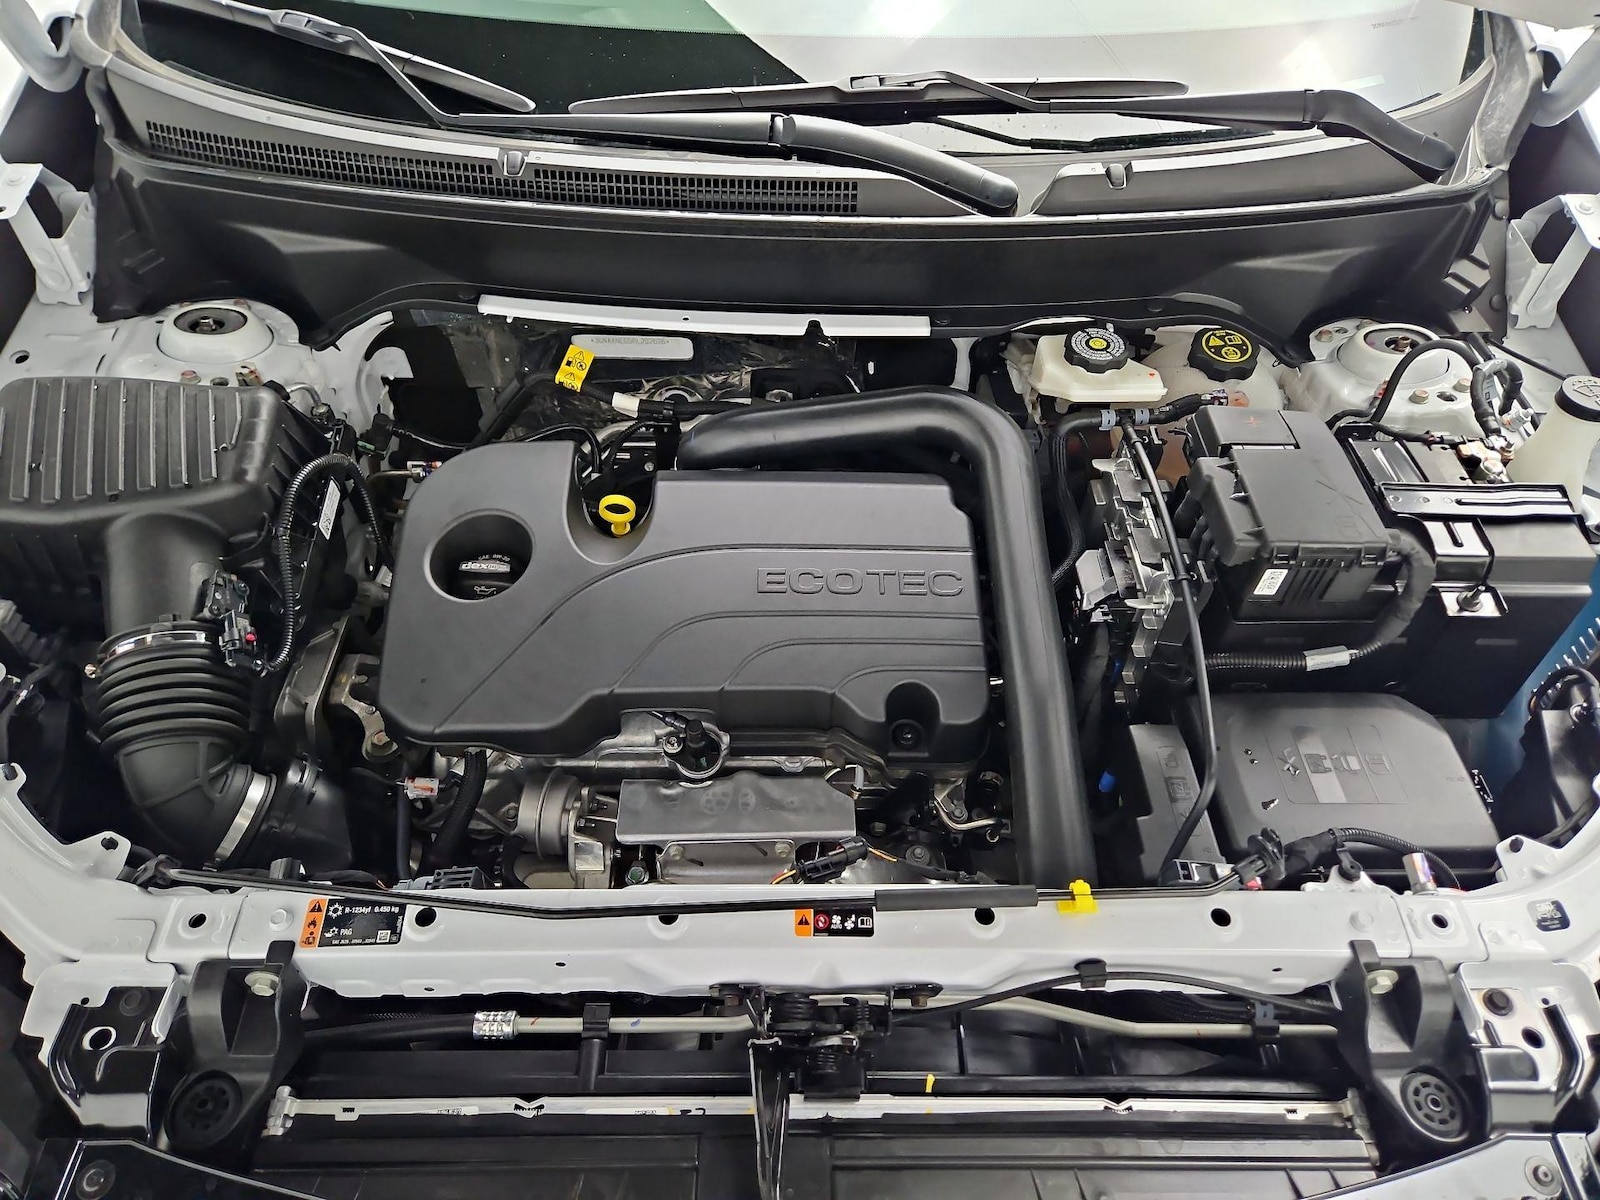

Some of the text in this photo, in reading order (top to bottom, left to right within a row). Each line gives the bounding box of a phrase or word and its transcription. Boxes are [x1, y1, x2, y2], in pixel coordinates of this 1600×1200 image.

[757, 568, 963, 597] ECOTEC
[344, 906, 372, 914] R-1234yf
[391, 906, 400, 914] kg
[340, 928, 353, 936] PAG
